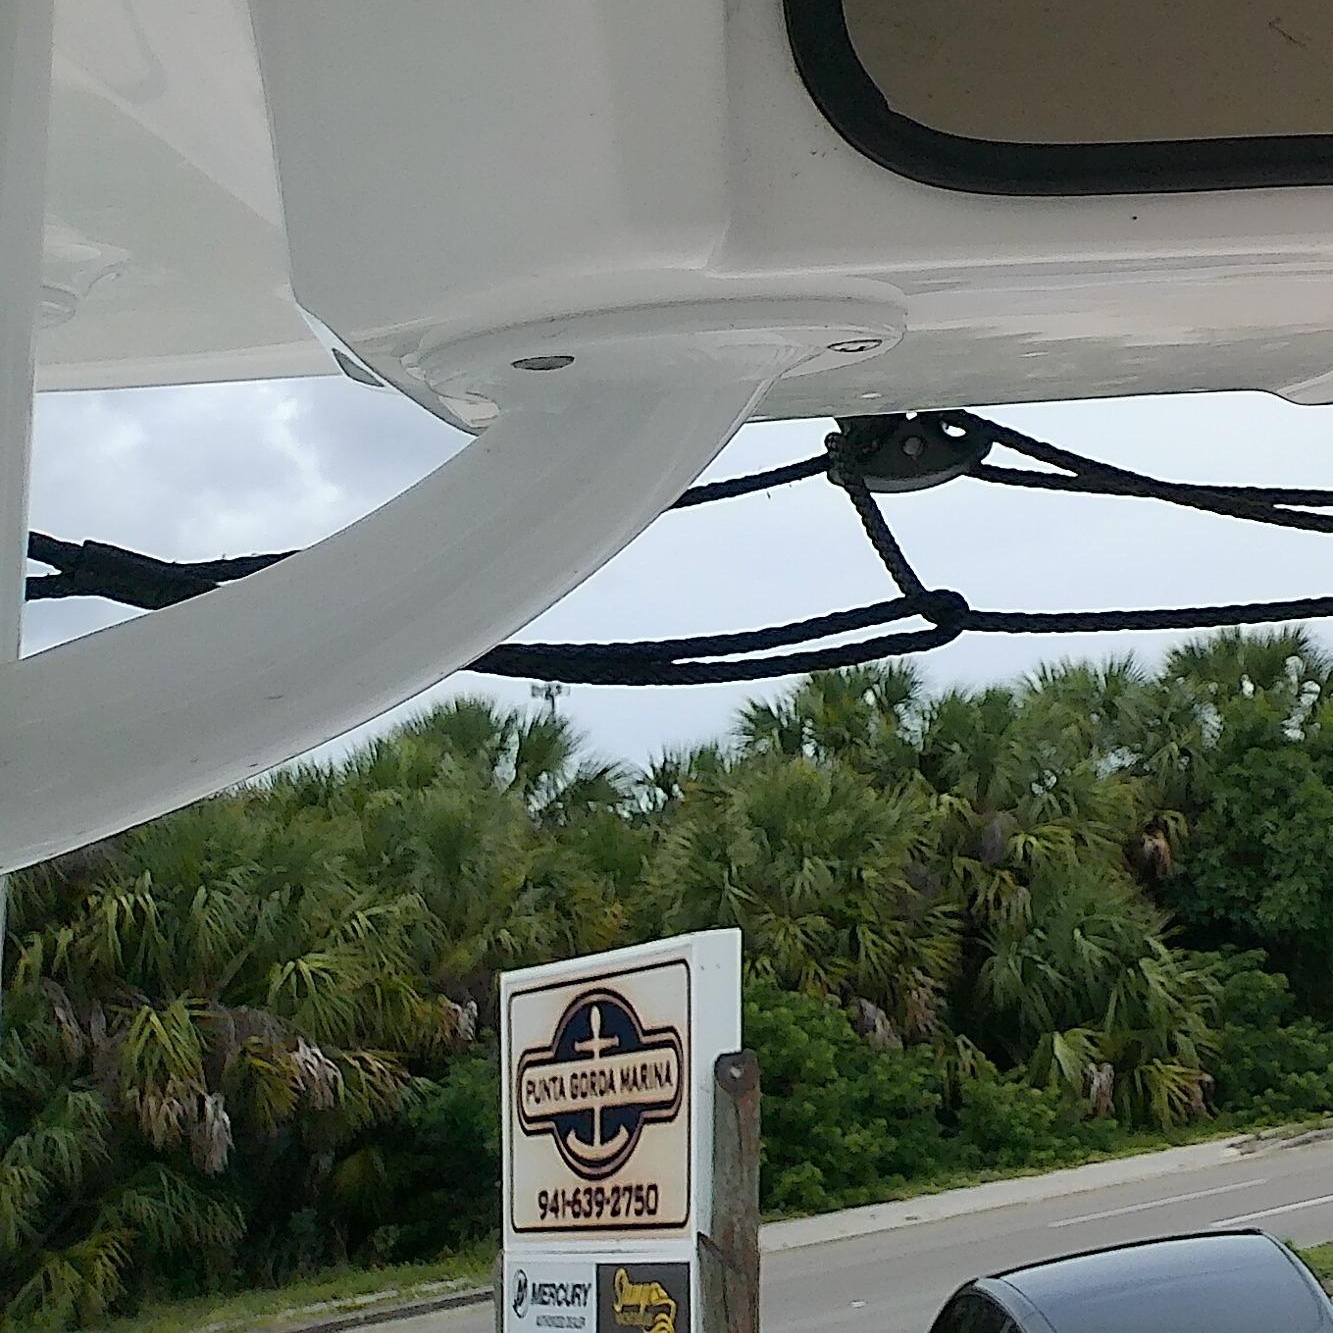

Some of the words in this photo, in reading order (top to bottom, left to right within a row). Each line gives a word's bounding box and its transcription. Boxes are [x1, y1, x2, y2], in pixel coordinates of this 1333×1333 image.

[526, 1076, 566, 1104] PUNTA
[570, 1069, 616, 1100] GORDA
[620, 1060, 673, 1093] MARINA
[538, 1183, 659, 1220] 941-639-2750
[531, 1282, 592, 1307] MERCURY
